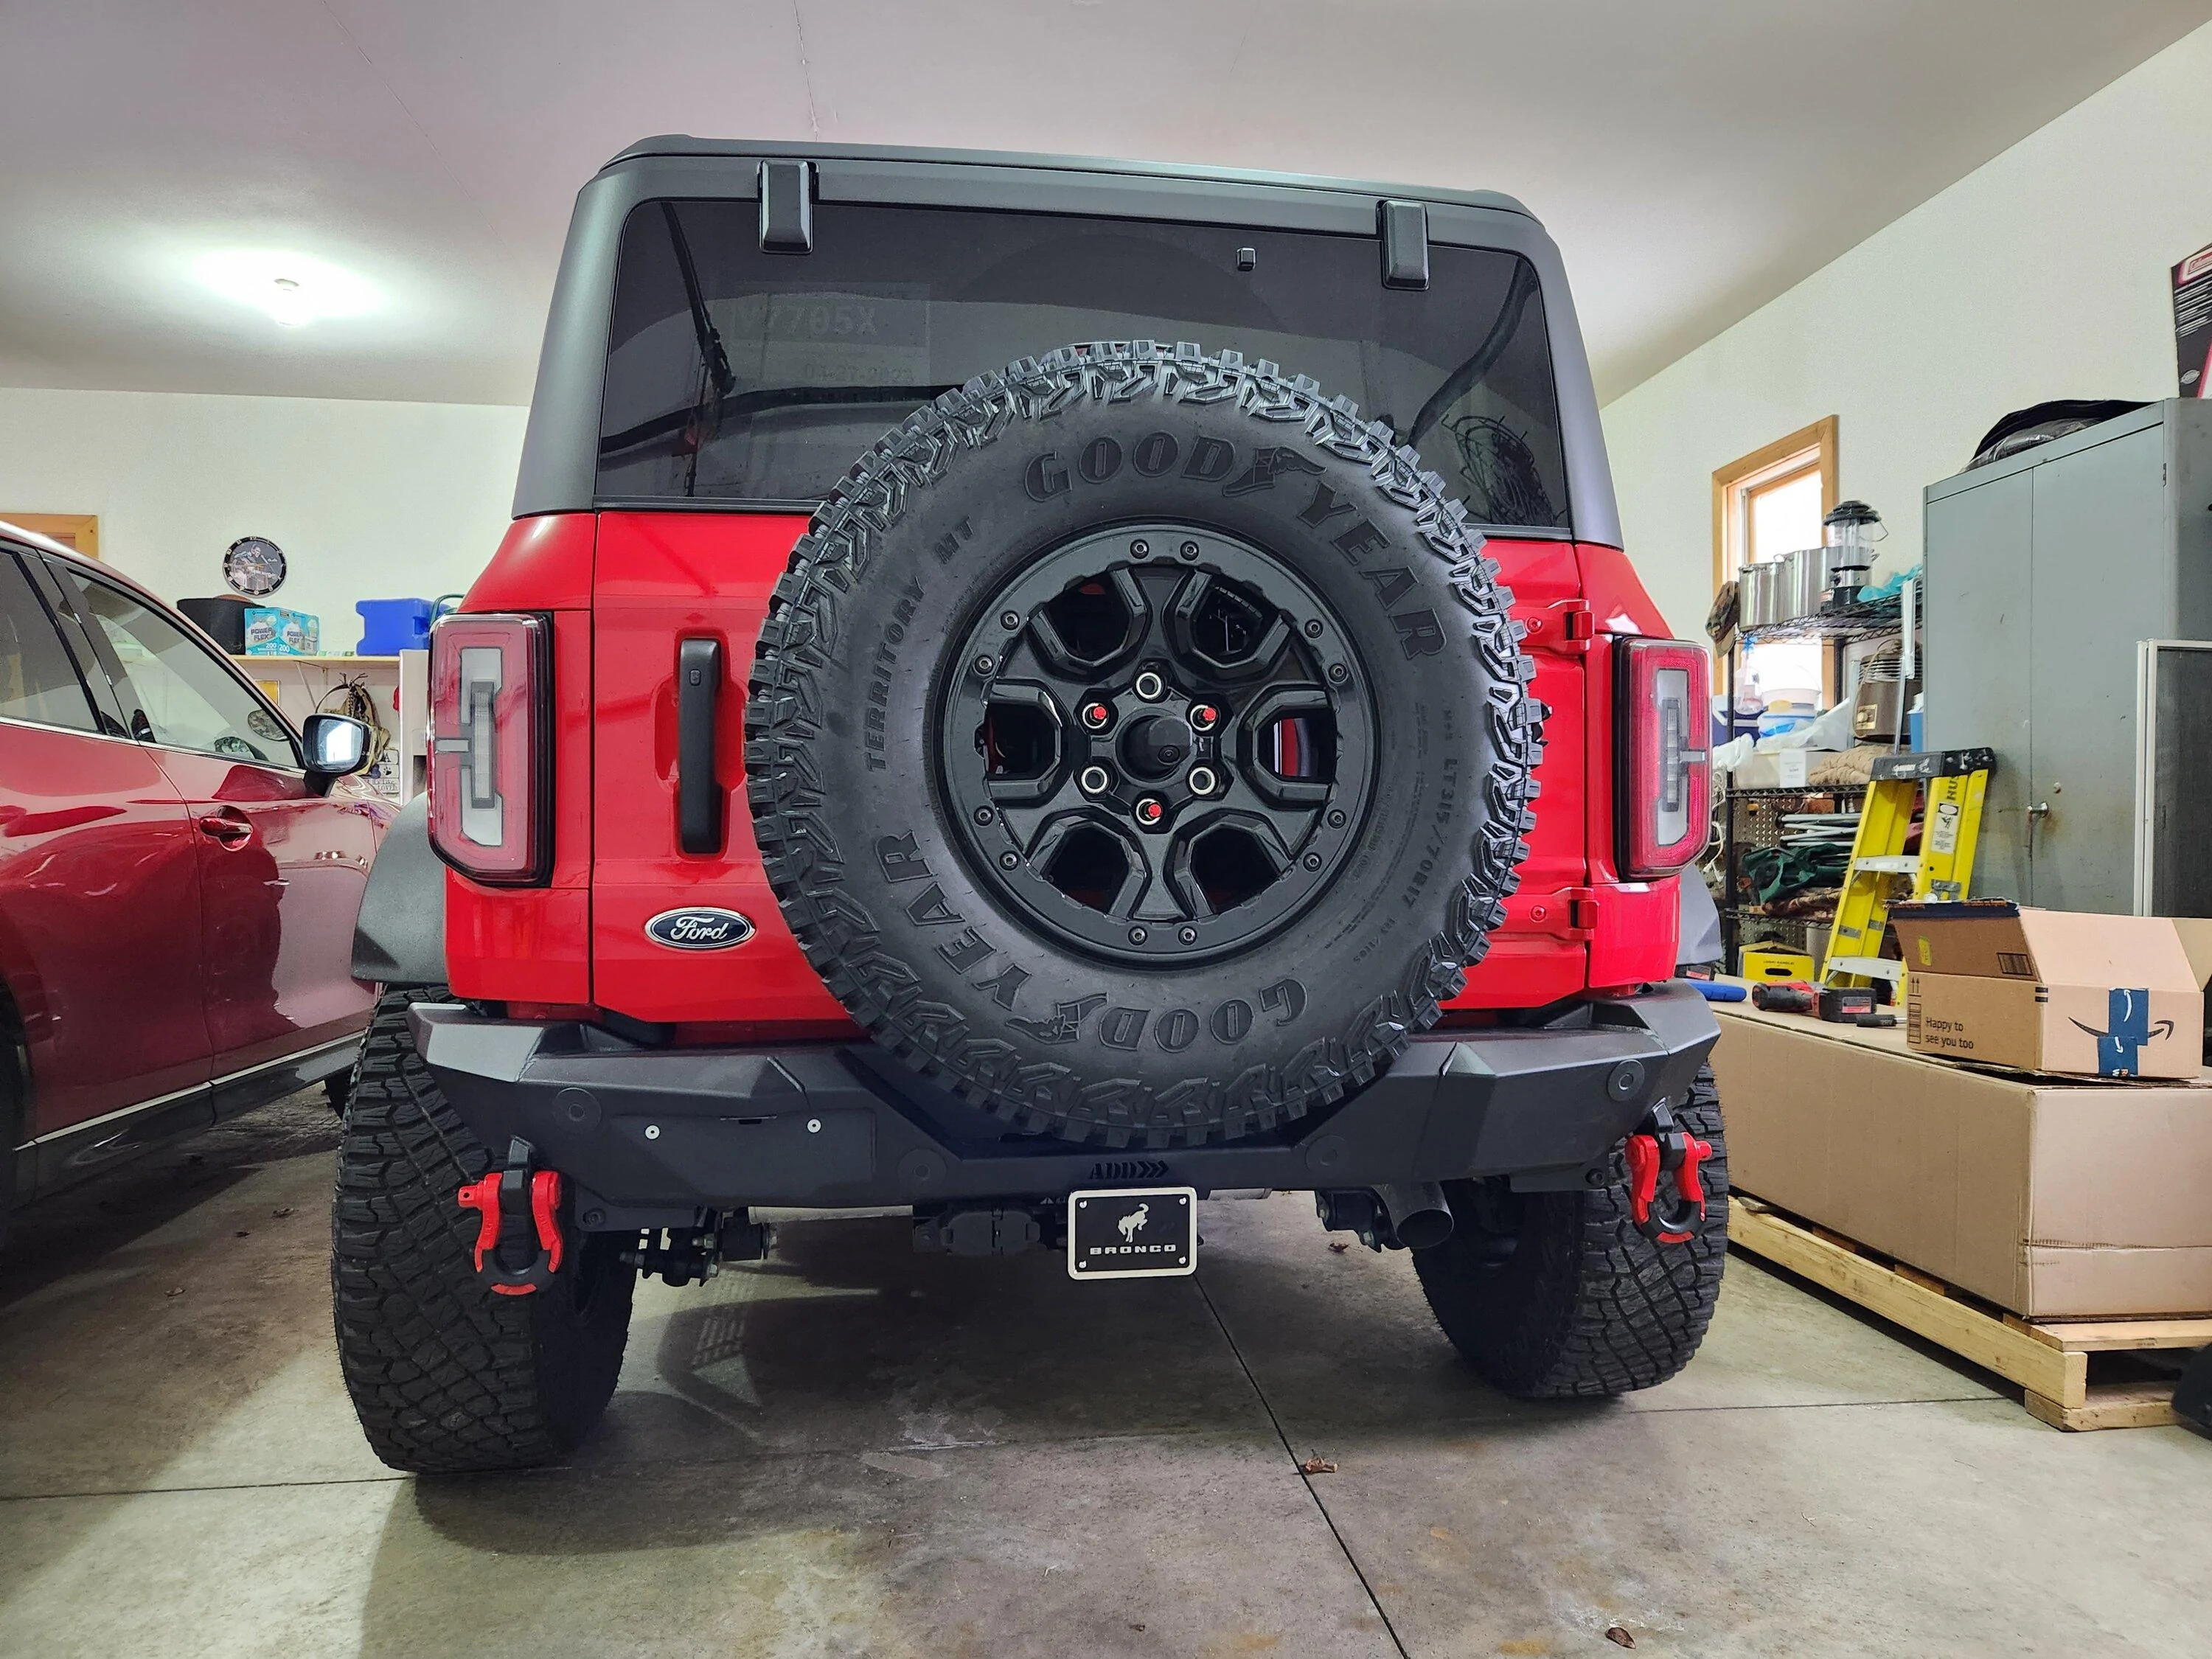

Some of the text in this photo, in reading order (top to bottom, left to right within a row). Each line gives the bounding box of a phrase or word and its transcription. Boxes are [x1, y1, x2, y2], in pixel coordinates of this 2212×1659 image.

[251, 627, 272, 636] POWER
[279, 644, 290, 653] 200
[865, 574, 926, 772] TERRITORY
[935, 514, 975, 564] MT
[669, 916, 729, 940] Ford
[1925, 1017, 1964, 1033] Happy to
[1925, 1034, 1974, 1049] see you too
[1090, 1244, 1176, 1255] BRONCO
